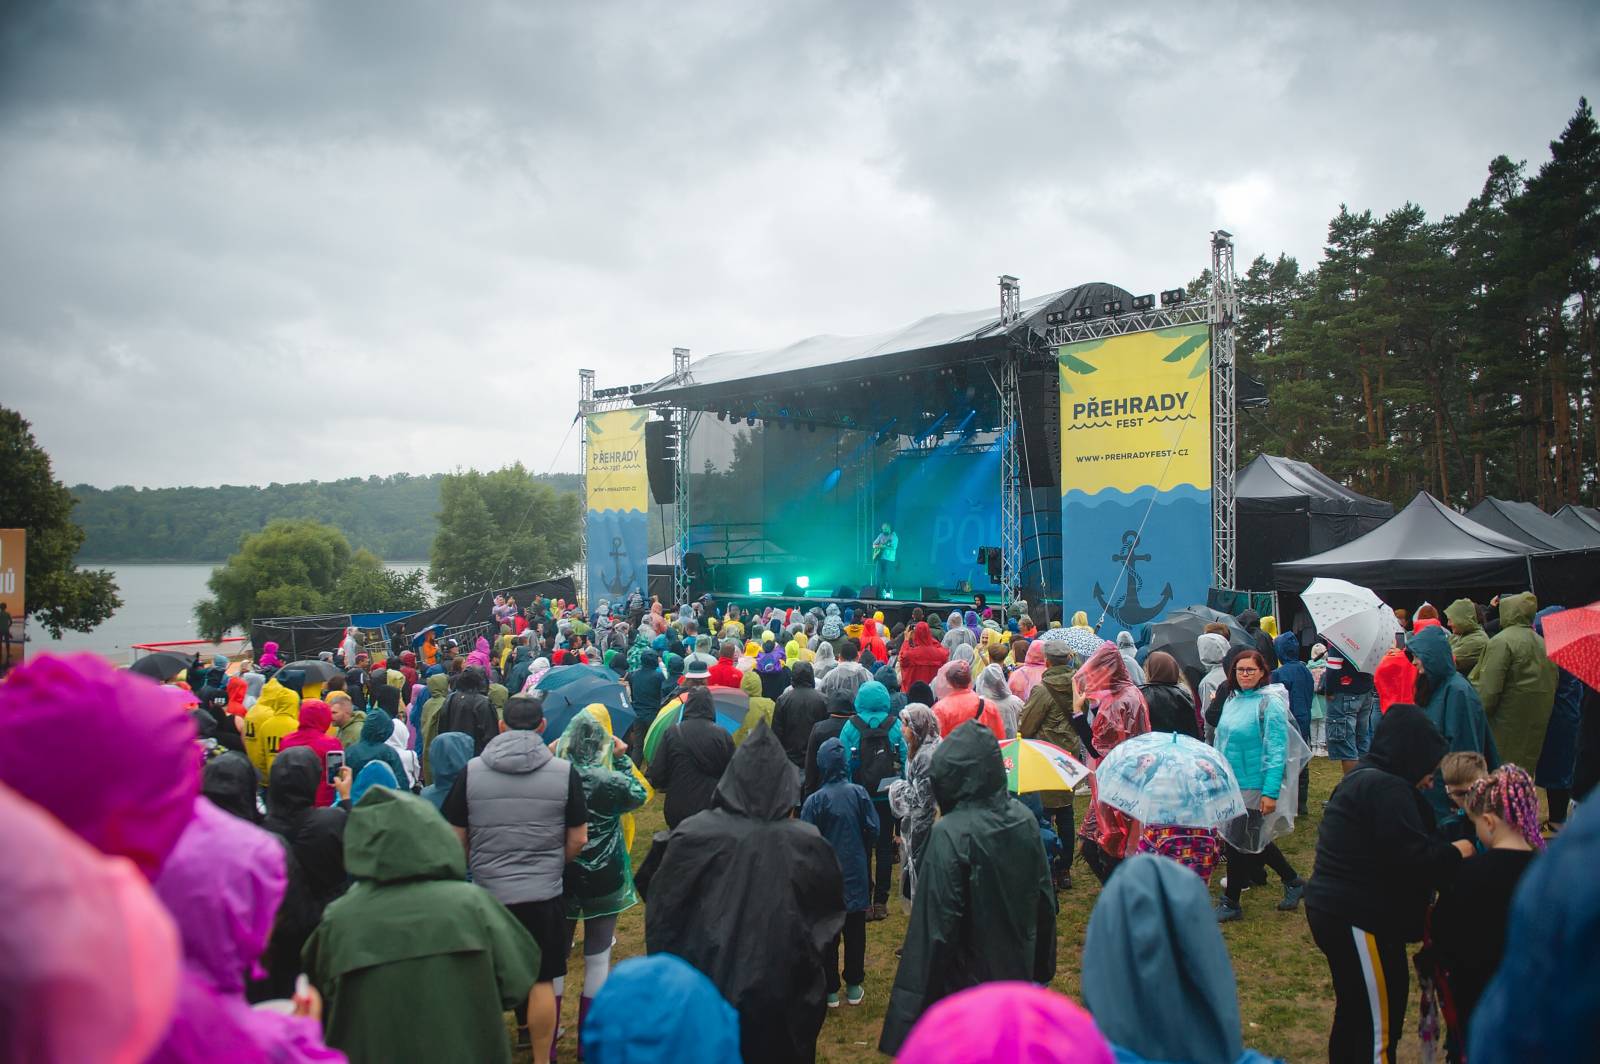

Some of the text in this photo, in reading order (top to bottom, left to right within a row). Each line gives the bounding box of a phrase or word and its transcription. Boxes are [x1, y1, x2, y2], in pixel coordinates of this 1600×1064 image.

[1073, 391, 1189, 420] PŘEHRADY
[1116, 418, 1144, 429] FEST
[593, 450, 639, 464] PŘEHRADY
